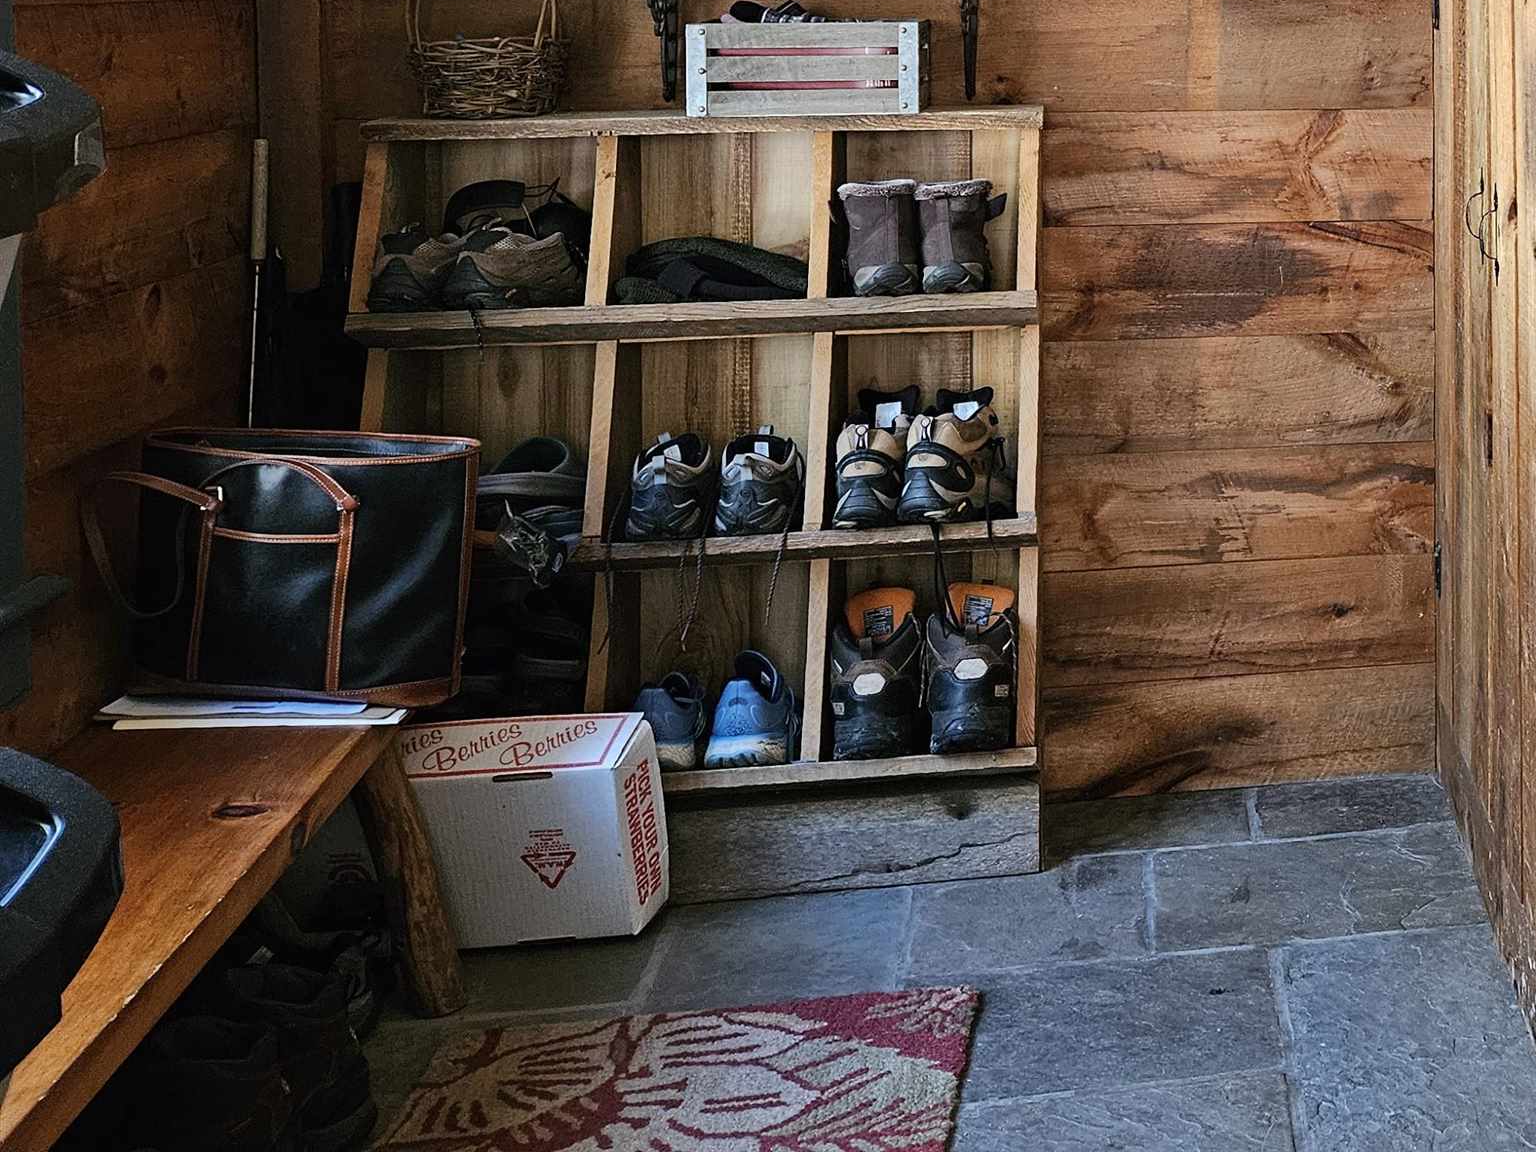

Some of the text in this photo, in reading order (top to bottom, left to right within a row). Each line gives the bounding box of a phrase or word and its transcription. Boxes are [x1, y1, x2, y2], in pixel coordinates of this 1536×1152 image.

[422, 723, 523, 771] Berries
[499, 720, 598, 767] Berries
[624, 773, 650, 906] STRAWBERRIES
[637, 759, 662, 896] PICK YOUR OWN
